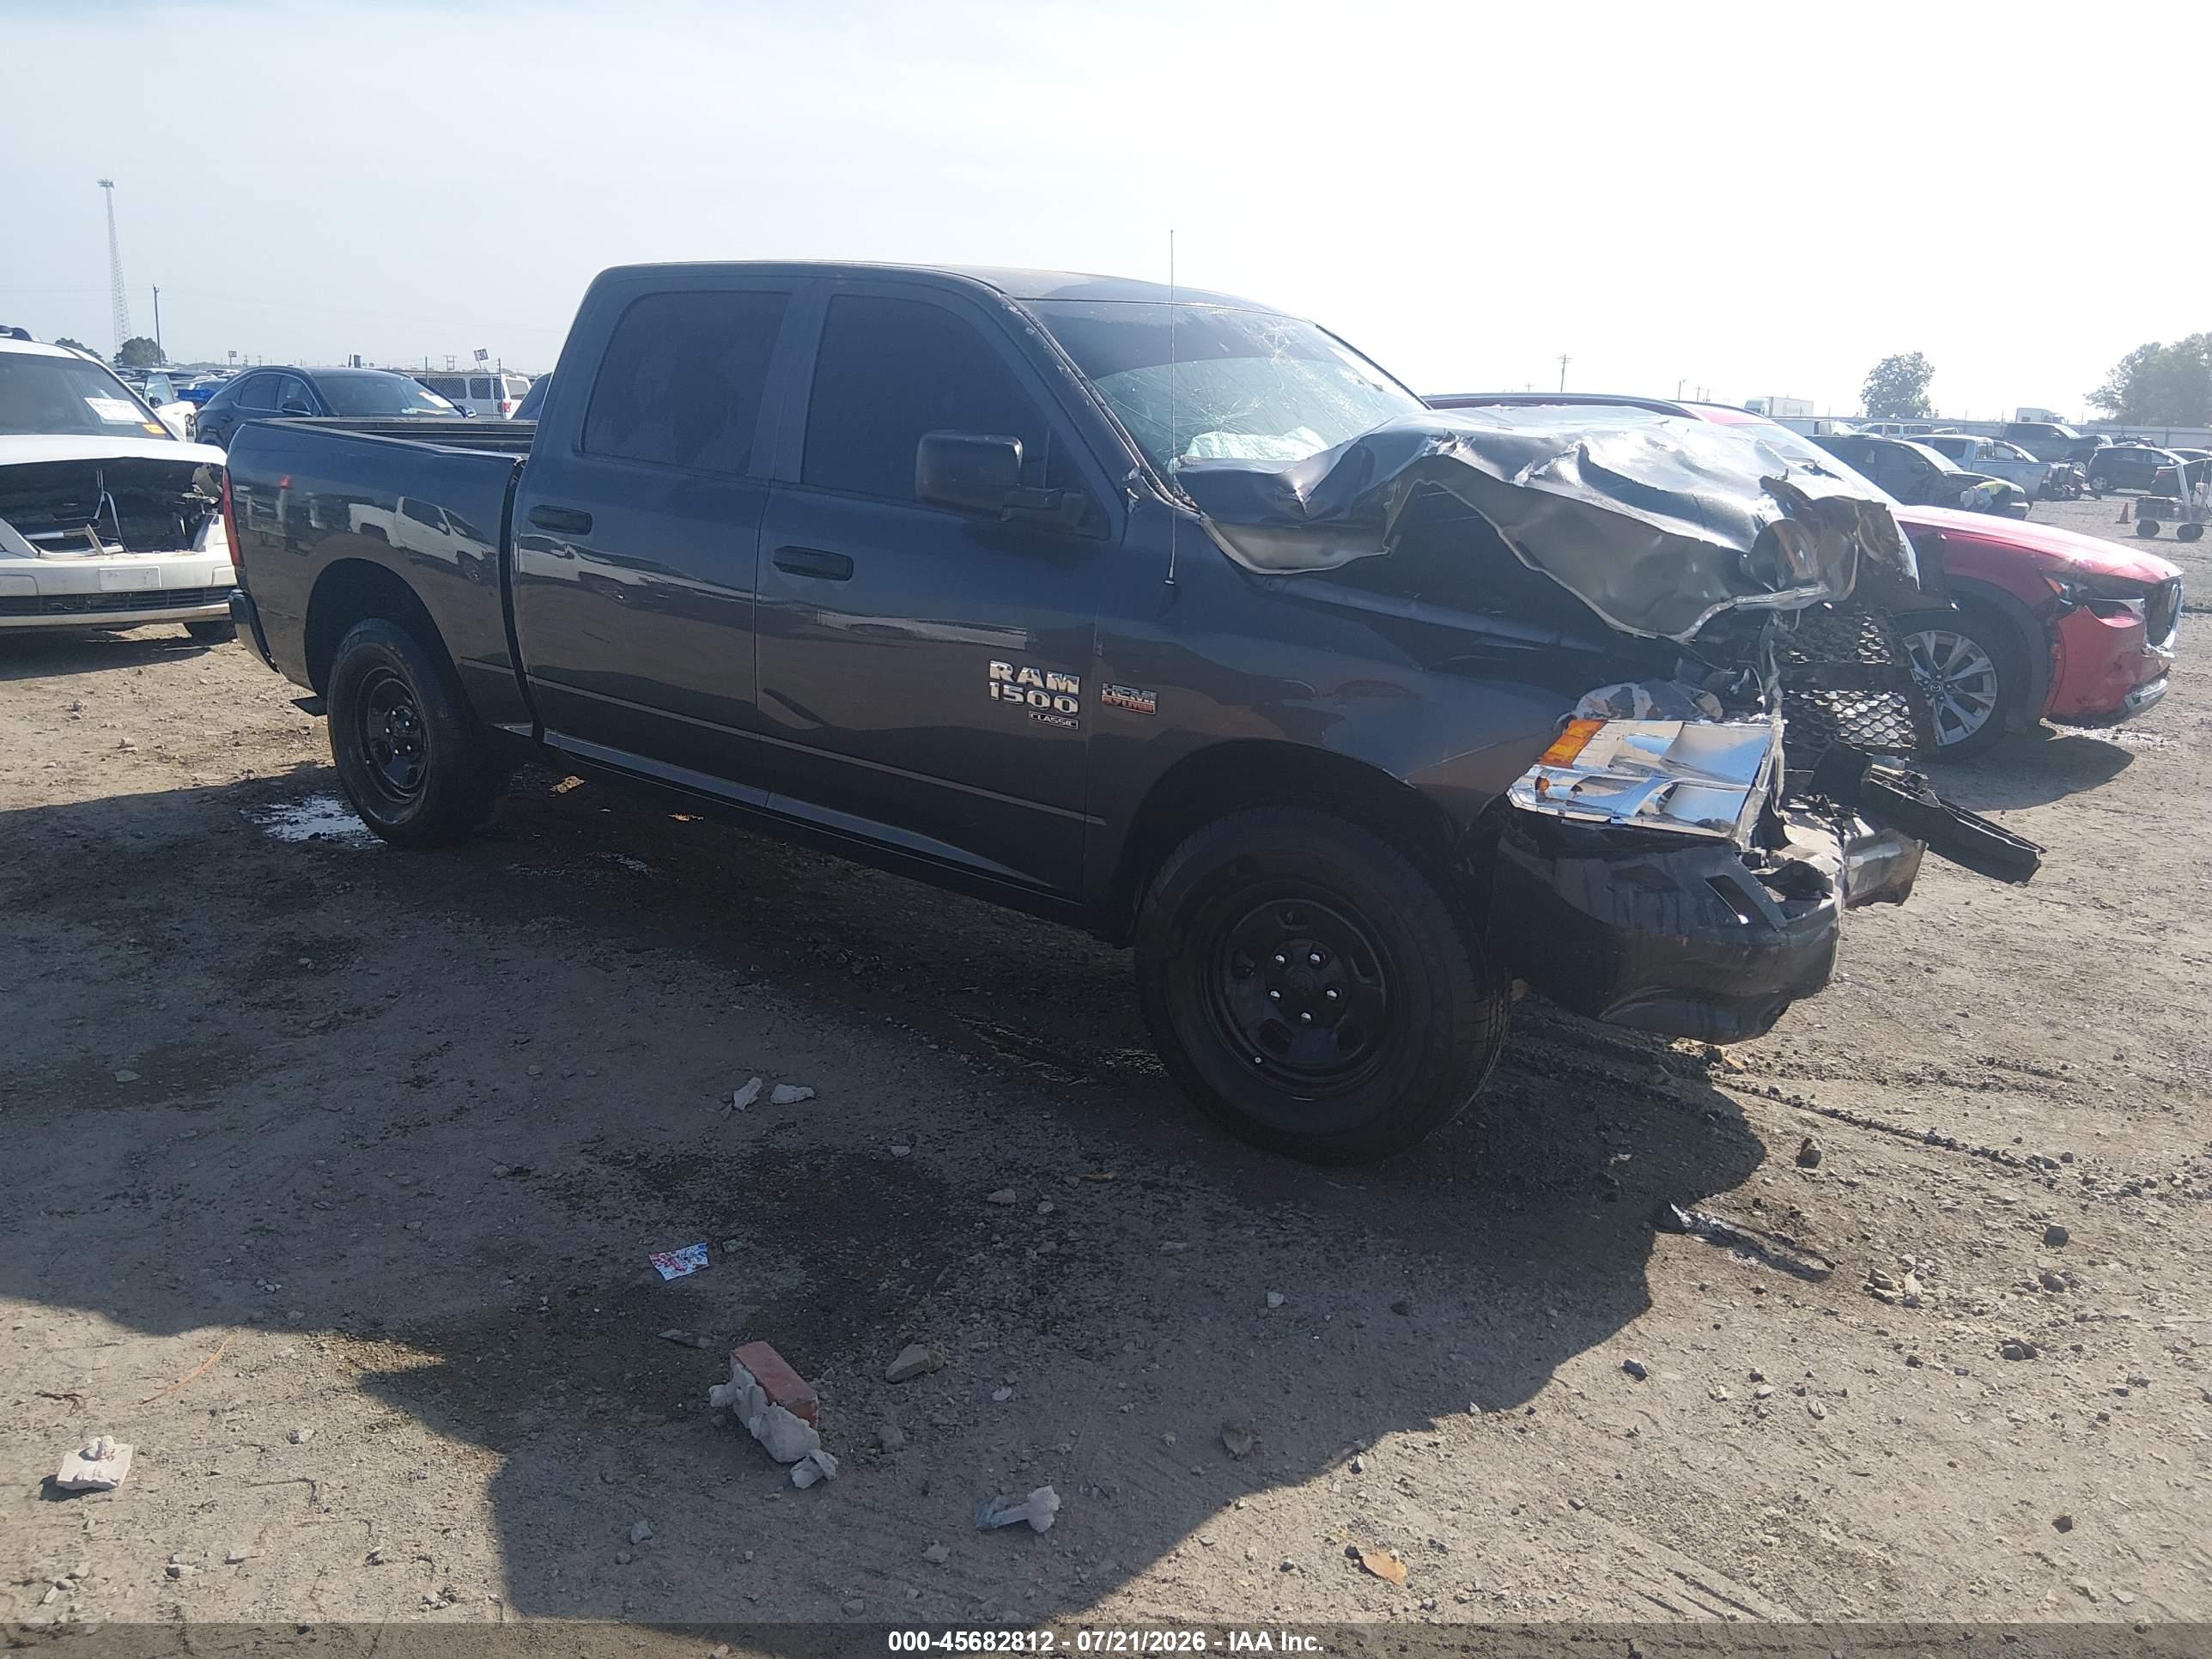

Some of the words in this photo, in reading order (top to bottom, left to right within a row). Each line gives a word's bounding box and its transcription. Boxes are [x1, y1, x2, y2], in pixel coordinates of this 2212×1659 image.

[989, 659, 1079, 695] RAM
[988, 681, 1079, 715] 1500
[1102, 683, 1157, 703] HEMI
[1030, 711, 1079, 729] CLASSIC
